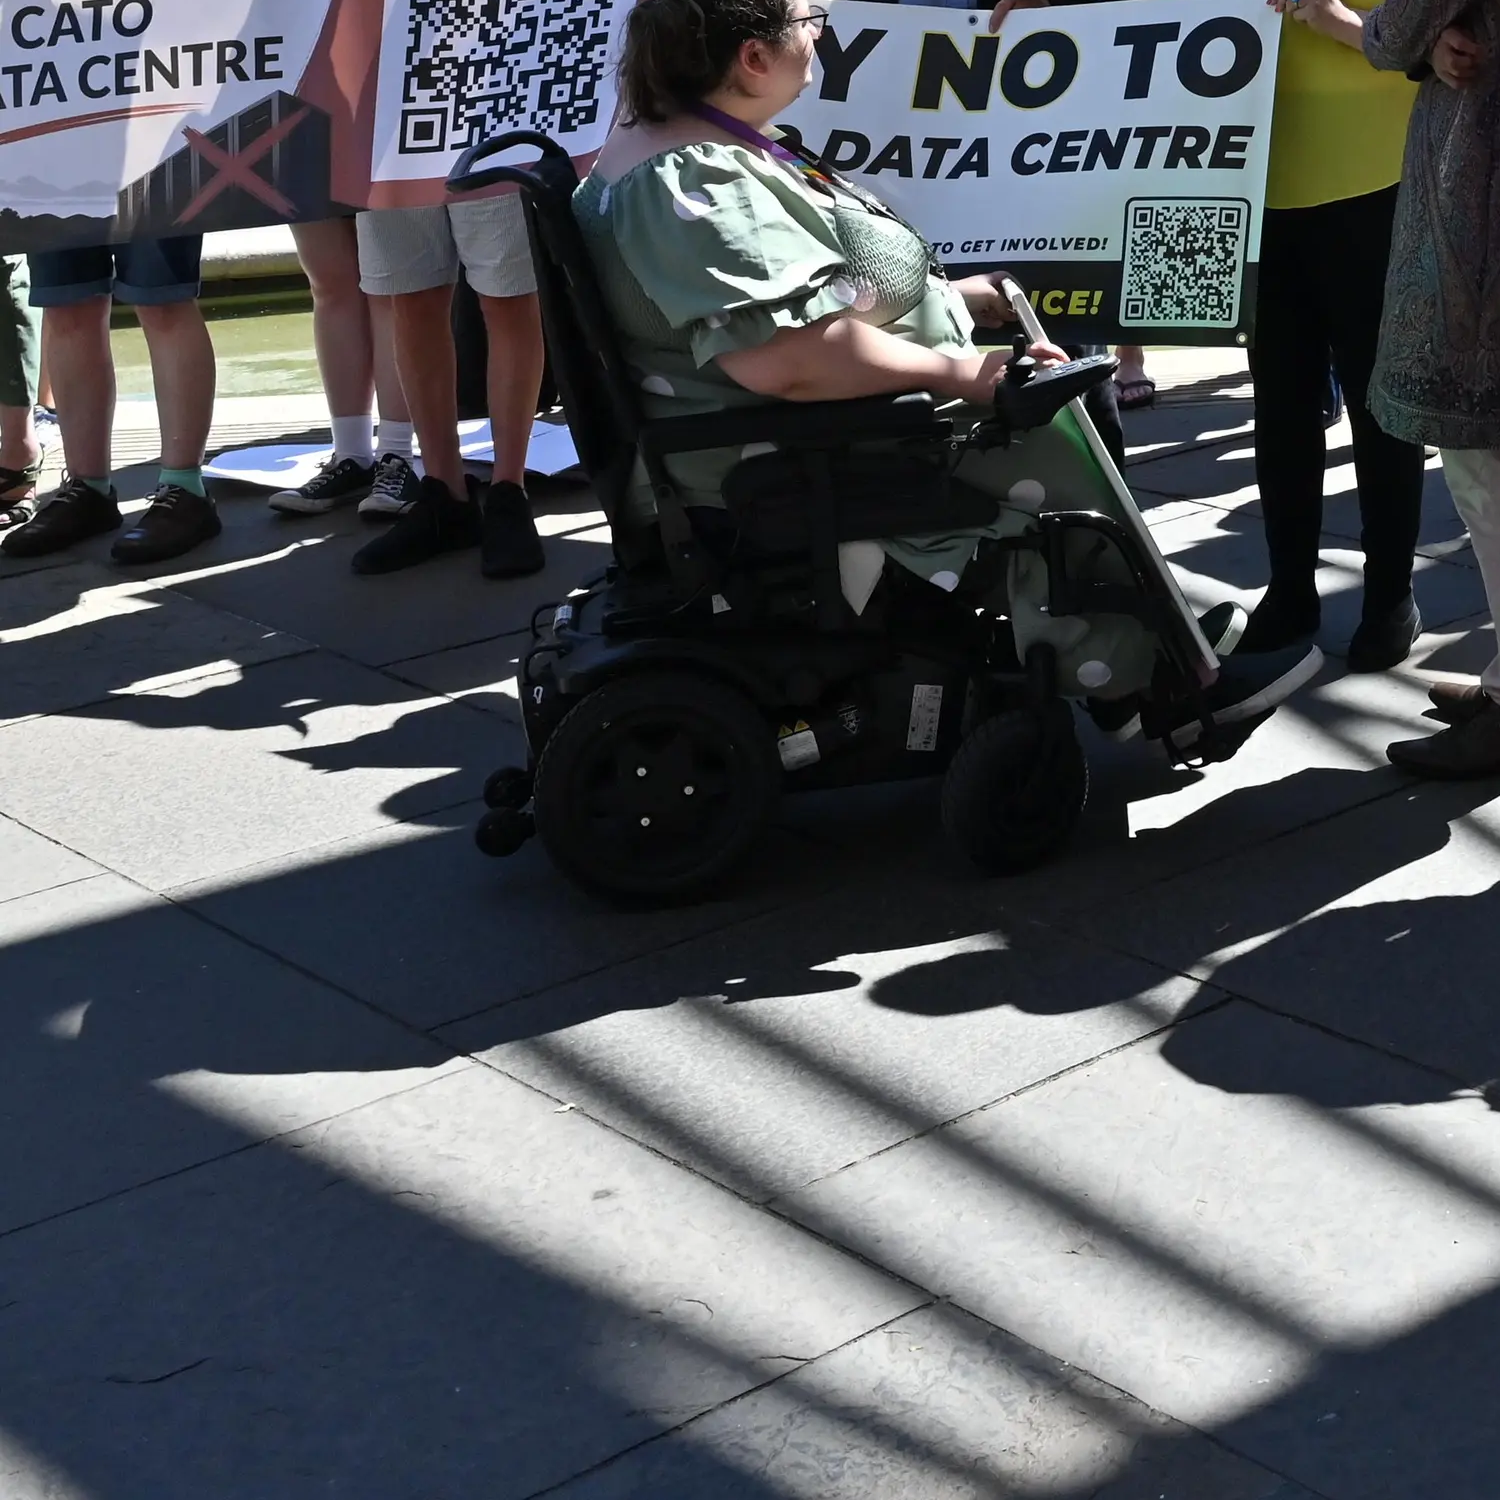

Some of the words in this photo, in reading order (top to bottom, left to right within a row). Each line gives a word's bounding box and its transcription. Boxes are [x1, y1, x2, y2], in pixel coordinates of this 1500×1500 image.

[78, 36, 283, 98] CENTRE
[911, 30, 1079, 113] NO
[1113, 16, 1263, 100] TO
[821, 128, 989, 179] DATA
[1010, 125, 1255, 176] CENTRE
[960, 239, 996, 253] GET
[1000, 237, 1108, 252] INVOLVED!
[1030, 290, 1103, 315] ICE!
